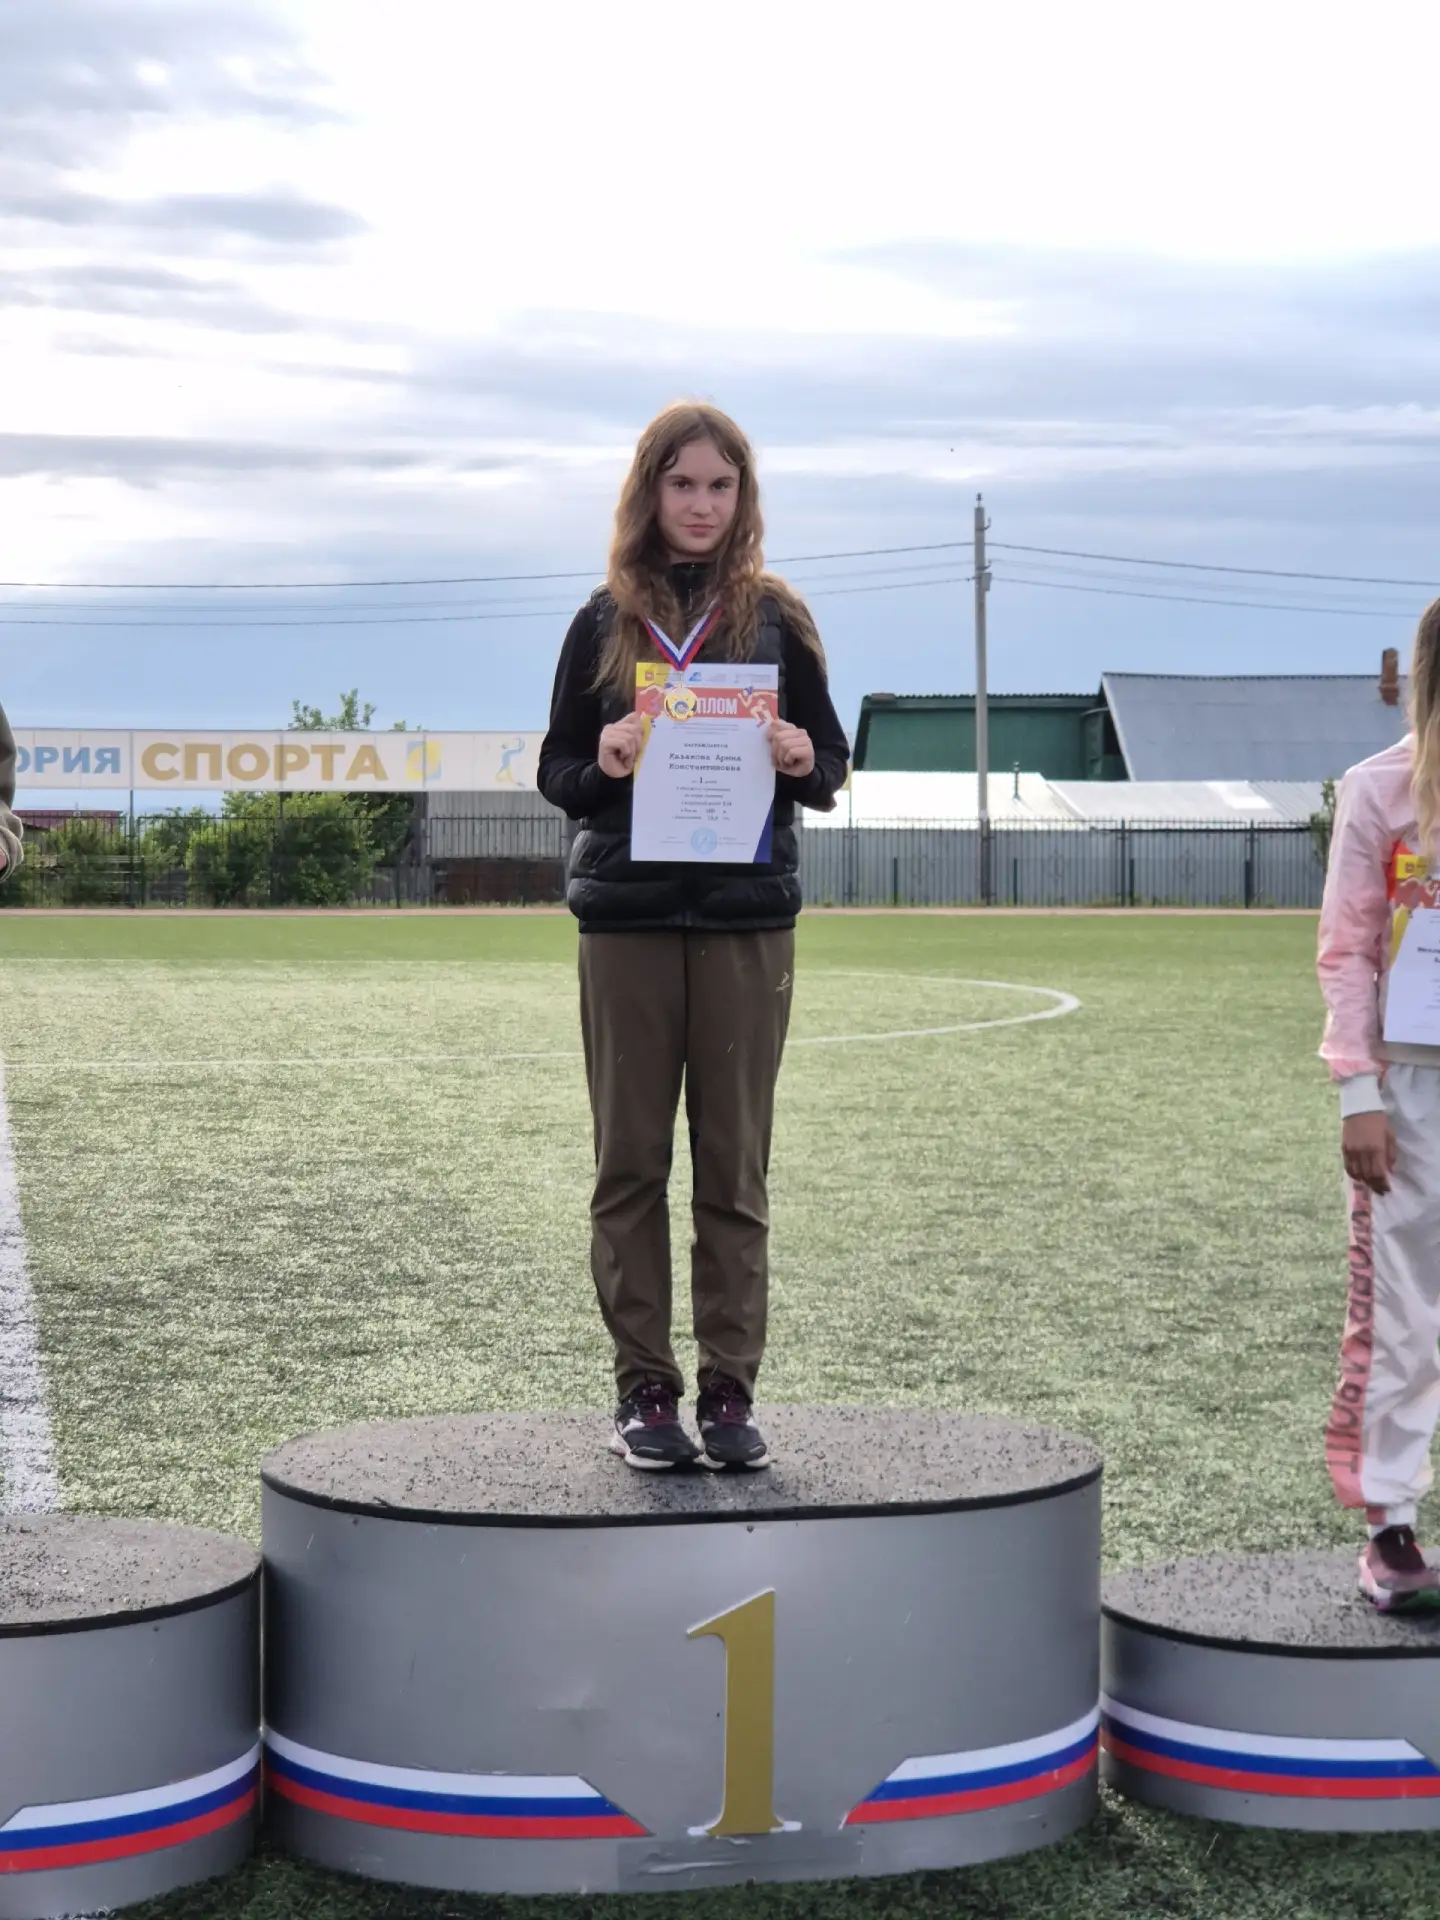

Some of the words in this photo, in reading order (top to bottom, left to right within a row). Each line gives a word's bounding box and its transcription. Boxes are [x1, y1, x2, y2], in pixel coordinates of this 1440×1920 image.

[697, 697, 737, 714] ПЛОМ
[141, 742, 390, 781] СПОРТА
[686, 1587, 802, 1836] 1
